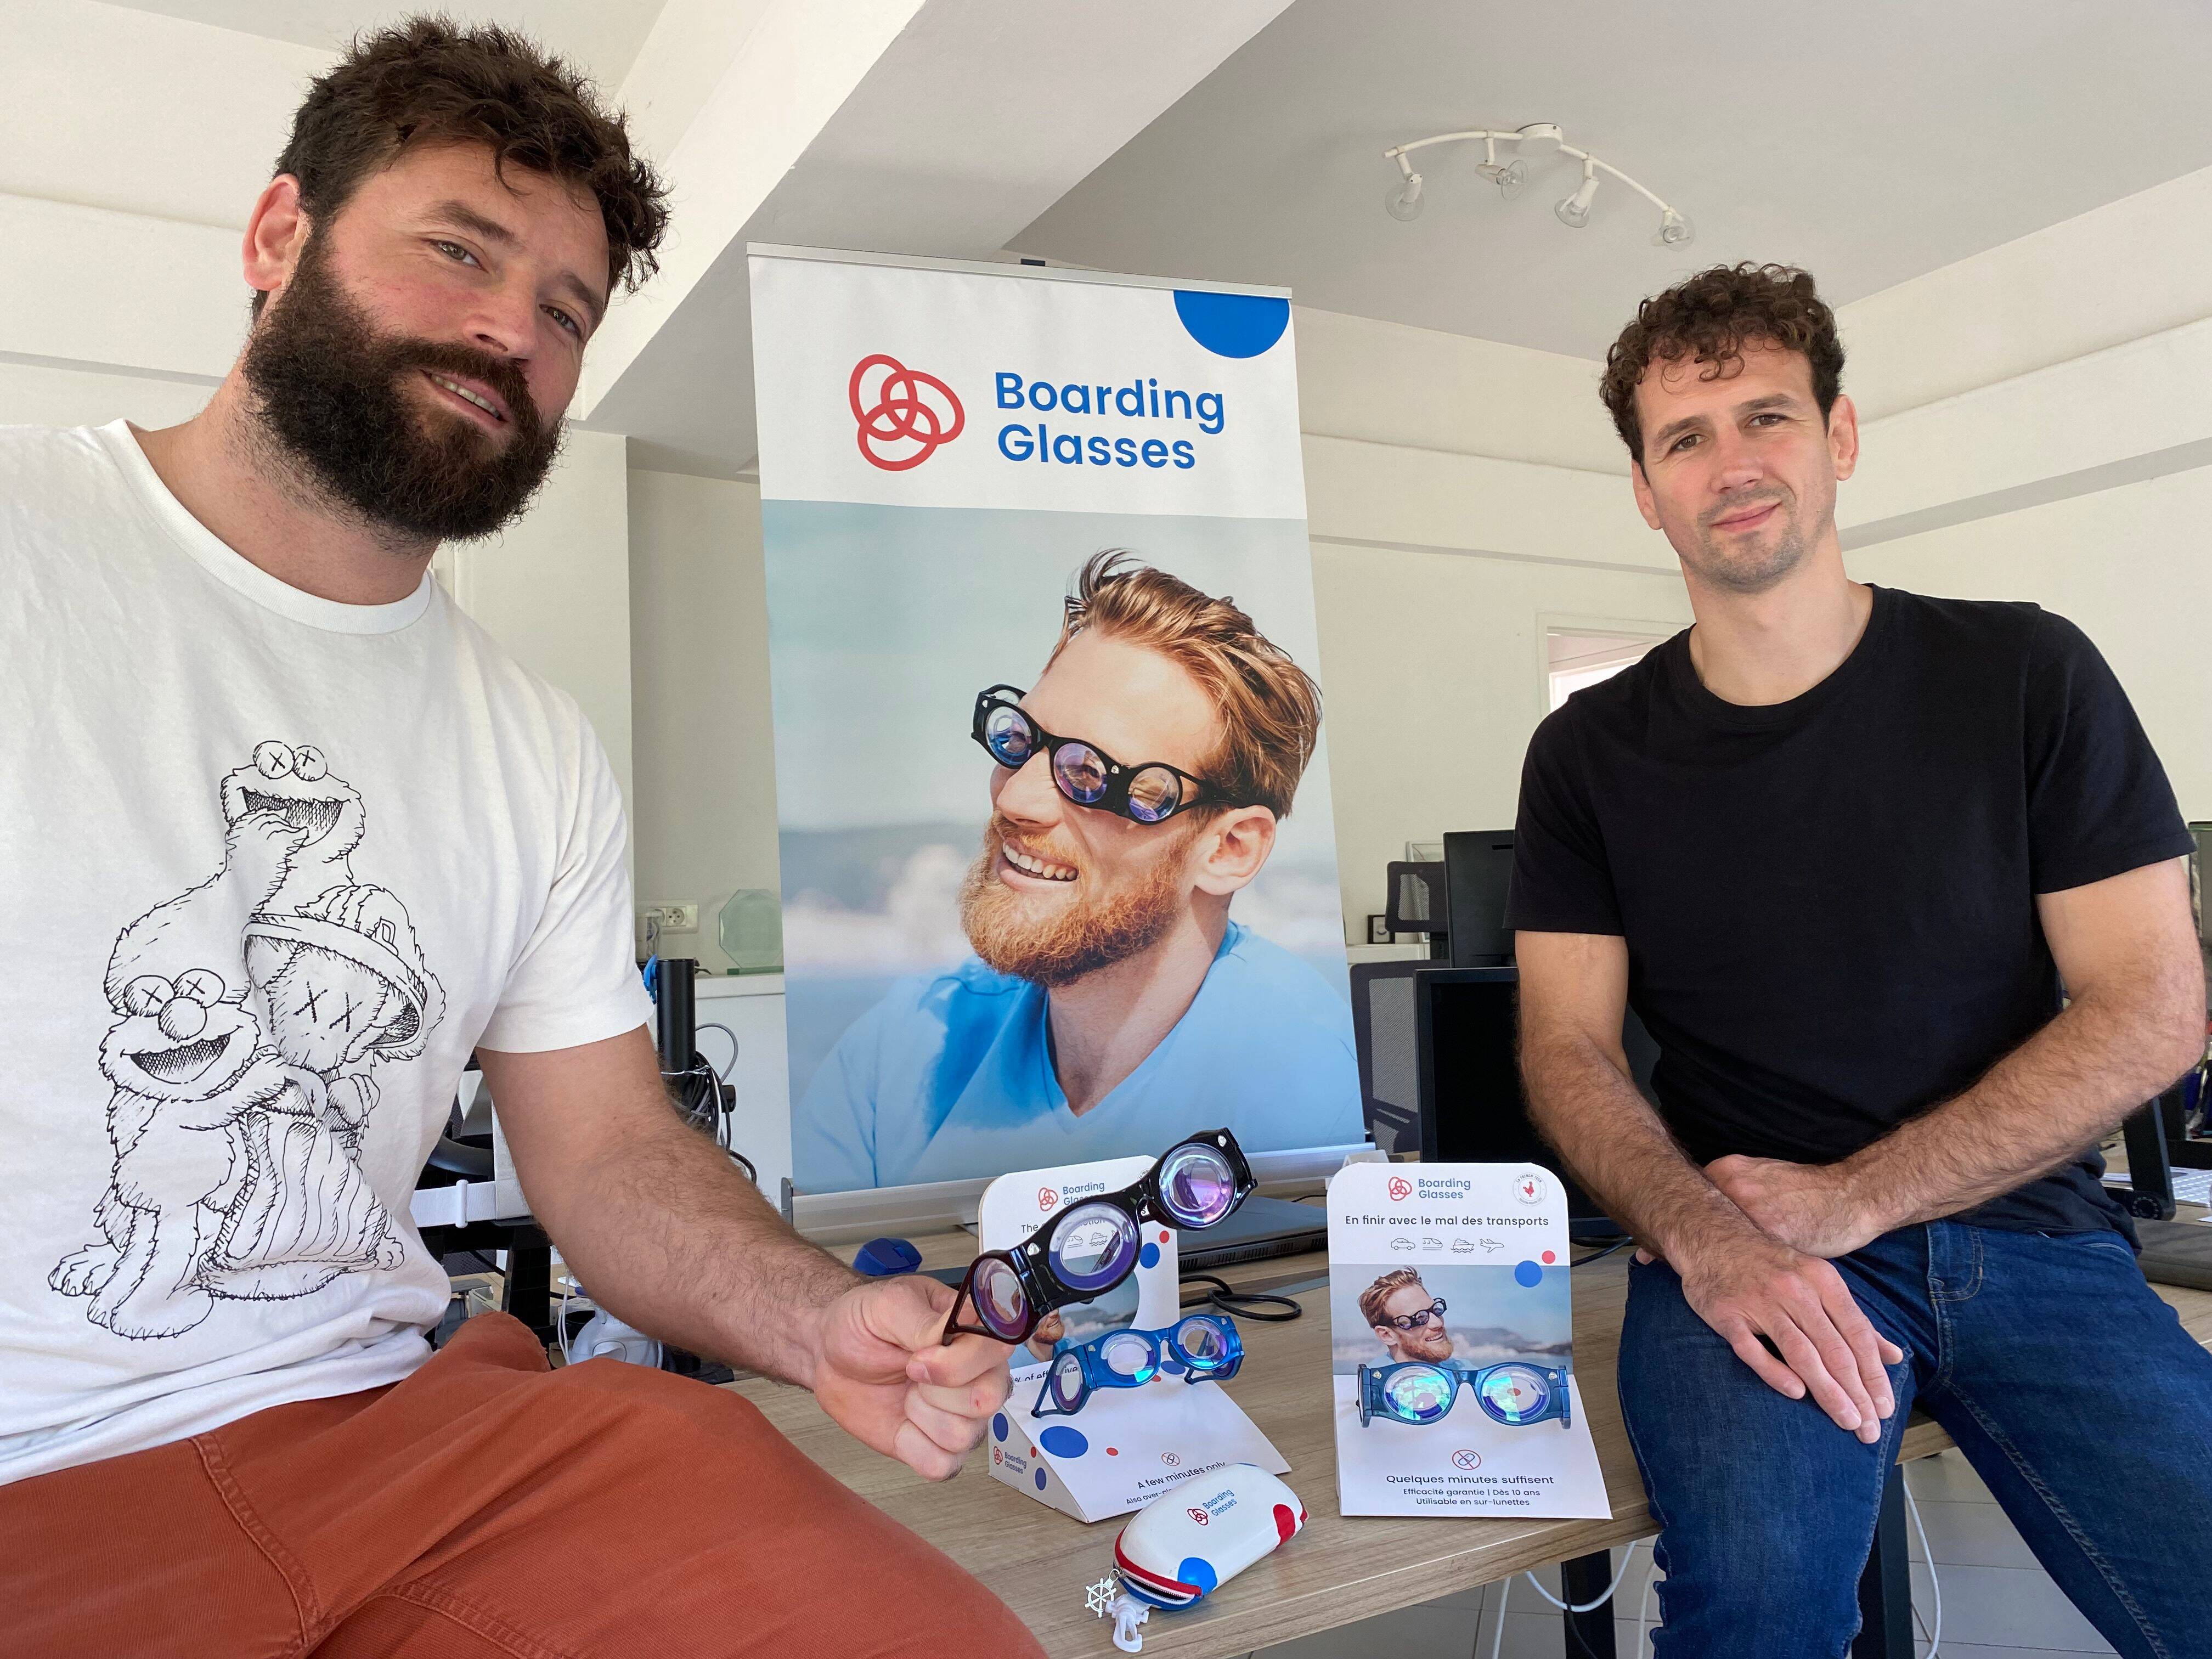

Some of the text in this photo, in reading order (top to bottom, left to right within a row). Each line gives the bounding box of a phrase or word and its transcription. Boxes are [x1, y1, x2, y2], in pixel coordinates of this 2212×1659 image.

[996, 372, 1225, 435] Boarding
[998, 424, 1196, 470] Glasses
[1063, 1181, 1104, 1195] Boarding
[1419, 1178, 1471, 1190] Boarding
[1419, 1189, 1464, 1199] Glasses
[1021, 1223, 1039, 1233] The
[1345, 1215, 1359, 1224] En
[1362, 1215, 1385, 1224] finir
[1421, 1216, 1431, 1225] le
[1435, 1216, 1458, 1225] mal
[1462, 1216, 1483, 1226] des
[1486, 1216, 1549, 1228] transports
[1005, 1452, 1027, 1469] Boarding
[1005, 1460, 1024, 1475] Glasses
[1145, 1477, 1164, 1487] few
[1165, 1468, 1205, 1482] minutes
[1386, 1475, 1555, 1485] Quelques minutes suffisent
[1202, 1489, 1235, 1509] Boarding
[1446, 1488, 1485, 1497] garantie
[1126, 1497, 1142, 1505] Also
[1211, 1499, 1237, 1516] Glasses
